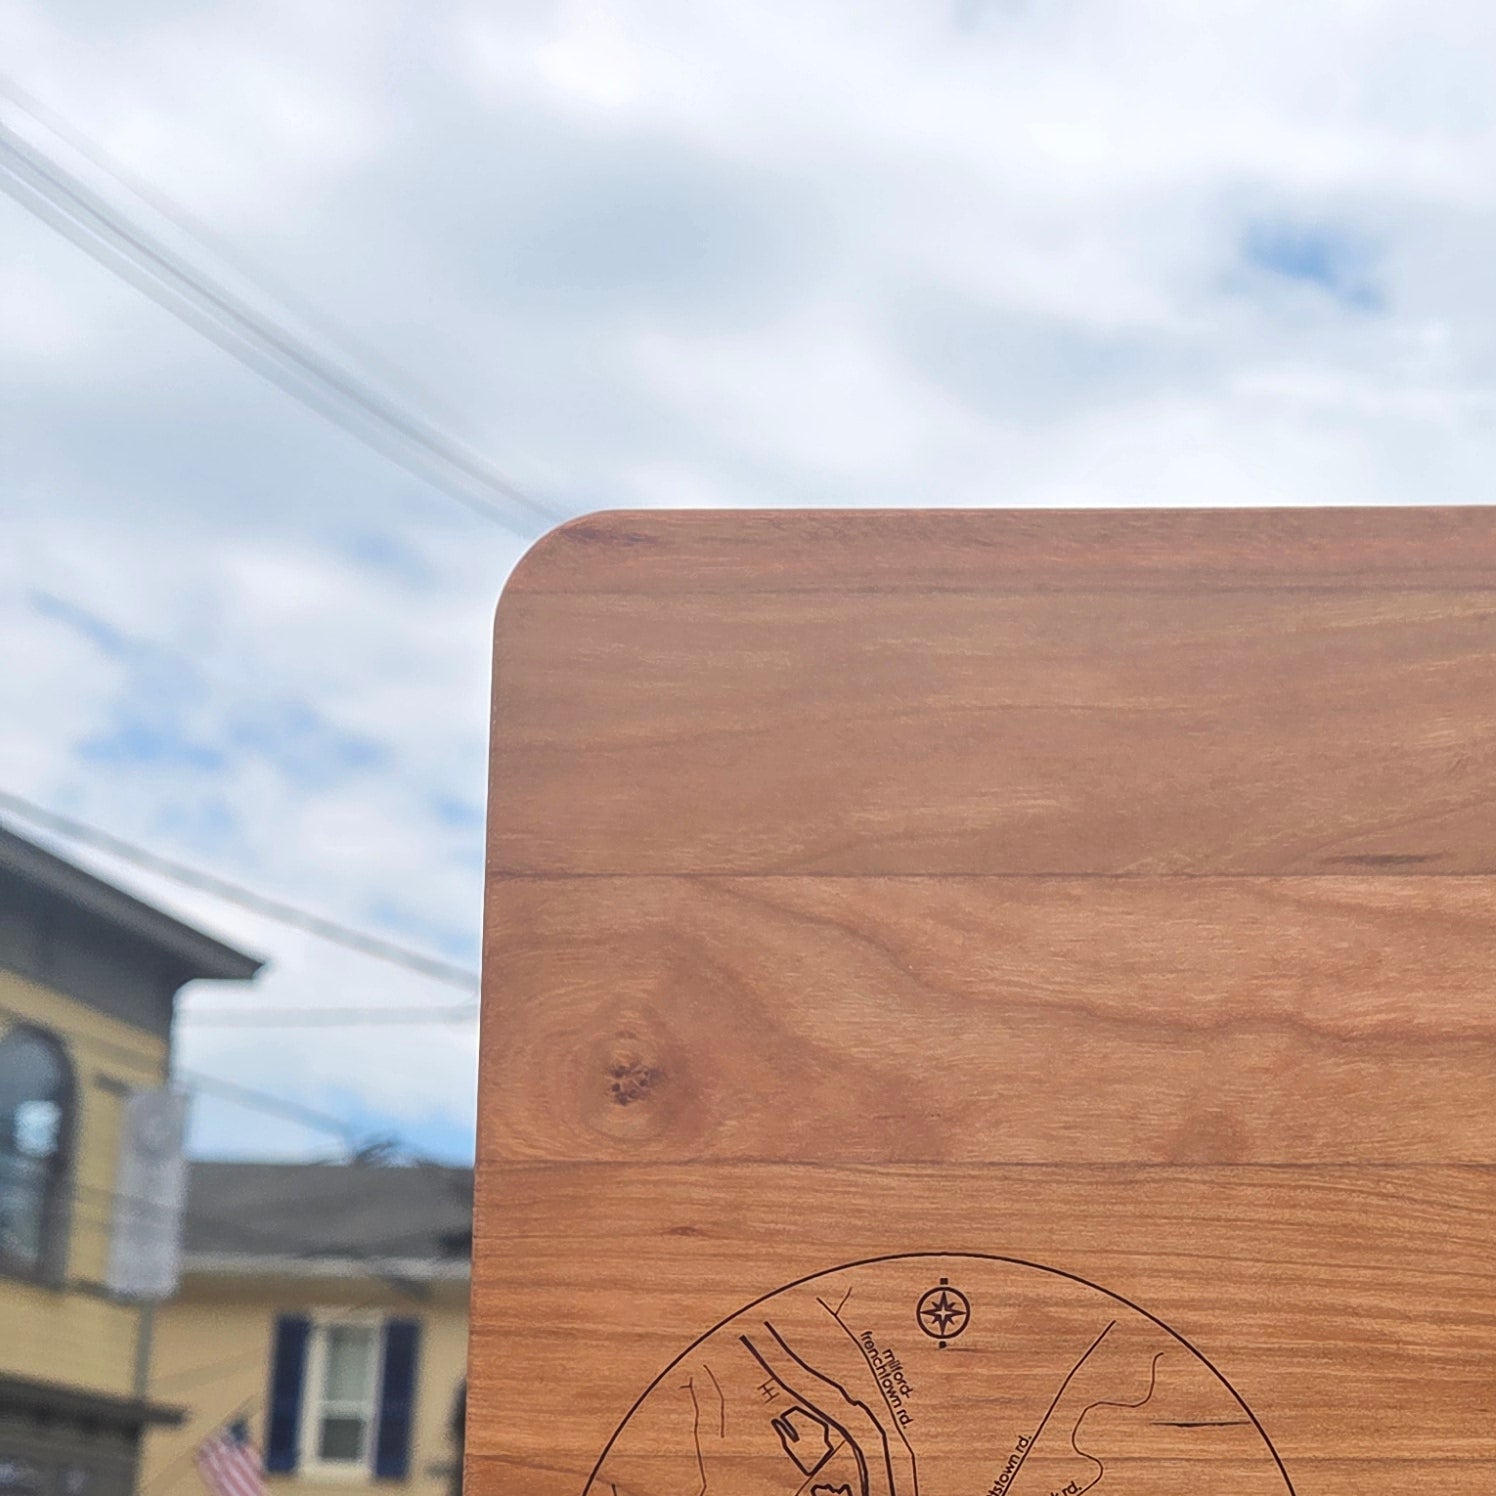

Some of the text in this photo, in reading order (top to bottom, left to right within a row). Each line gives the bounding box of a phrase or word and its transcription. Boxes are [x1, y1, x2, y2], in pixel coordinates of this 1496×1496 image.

[861, 1331, 914, 1429] frenchtown rd.
[1016, 1435, 1032, 1454] rd.
